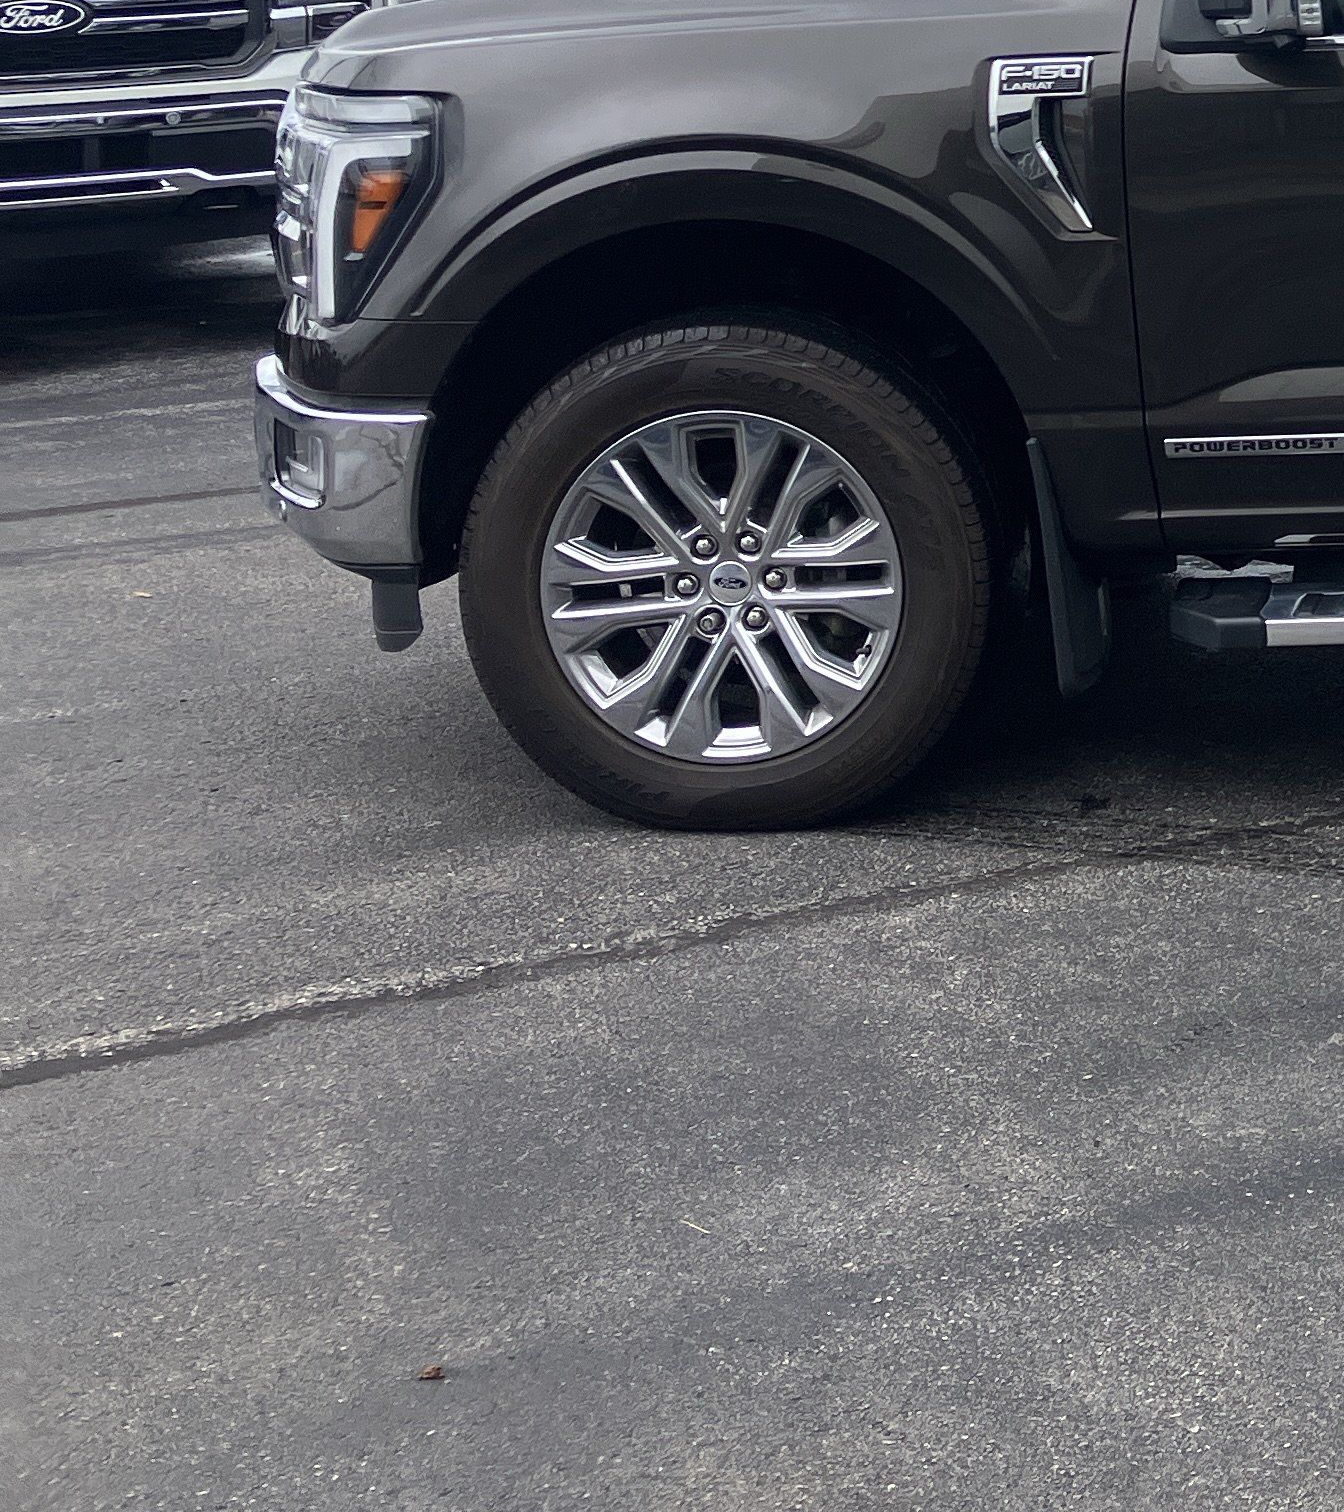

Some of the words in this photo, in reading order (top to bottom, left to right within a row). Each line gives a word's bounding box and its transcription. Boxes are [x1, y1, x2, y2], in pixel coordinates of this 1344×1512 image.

[0, 4, 66, 29] Ford
[1001, 64, 1083, 81] F-150
[1002, 81, 1056, 91] LARIAT
[1173, 438, 1339, 454] POWERBOOST
